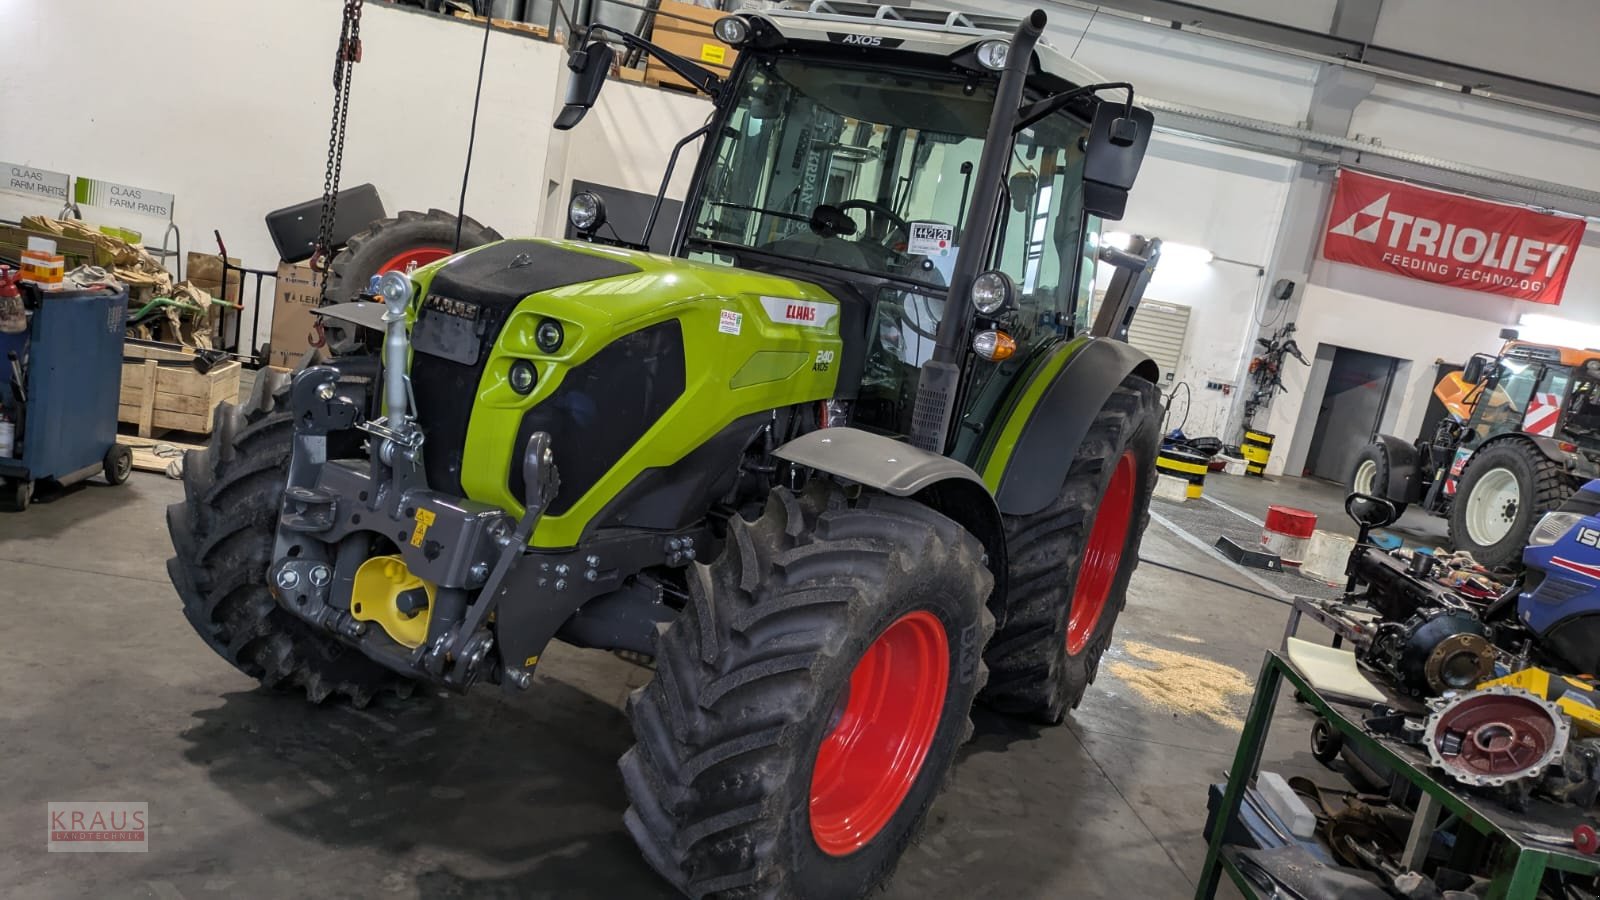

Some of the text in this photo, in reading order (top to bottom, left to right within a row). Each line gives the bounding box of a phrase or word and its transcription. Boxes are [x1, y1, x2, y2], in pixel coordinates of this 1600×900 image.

[842, 34, 883, 46] AXOS
[11, 167, 43, 181] CLAAS
[801, 149, 820, 205] KRPAN
[10, 178, 65, 197] FARM PARTS
[110, 185, 142, 200] CLAAS
[109, 198, 167, 216] FARM PARTS
[1386, 210, 1568, 278] TRIOLIET
[1382, 252, 1449, 276] FEEDING
[786, 304, 815, 321] CLAAS
[815, 350, 834, 364] 240
[812, 362, 829, 372] AXOS
